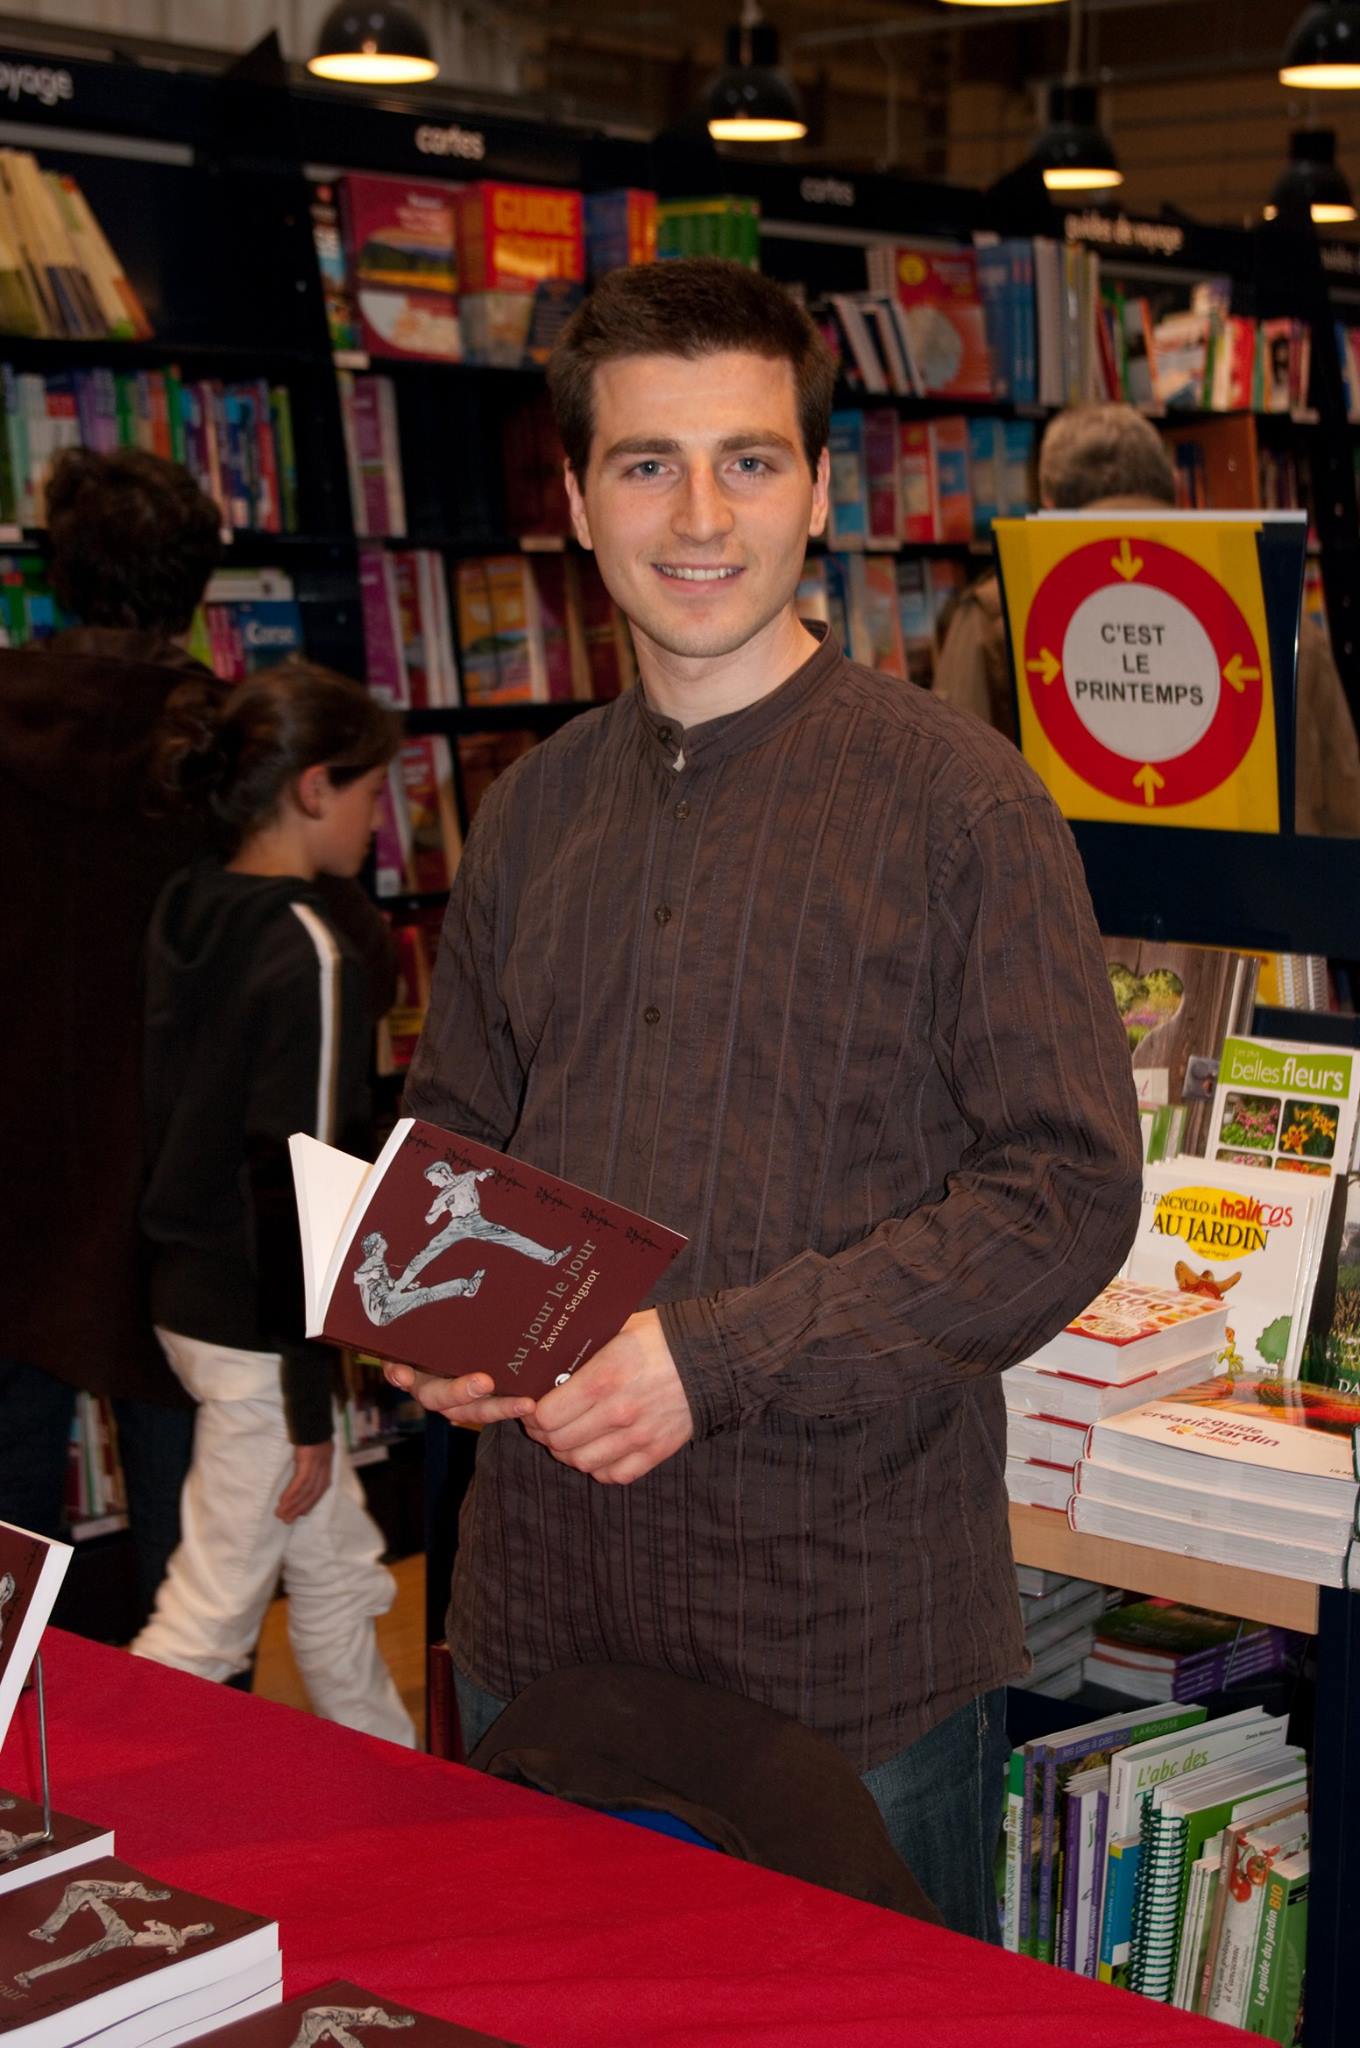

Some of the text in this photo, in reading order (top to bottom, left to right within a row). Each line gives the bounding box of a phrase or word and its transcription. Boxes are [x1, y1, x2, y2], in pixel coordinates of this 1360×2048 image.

[1101, 624, 1164, 645] C'EST
[1122, 654, 1149, 674] LE
[1075, 680, 1203, 706] PRINTEMPS
[1231, 1057, 1344, 1092] belles fleurs
[1142, 1192, 1209, 1214] L'ENCYCLO
[1220, 1196, 1293, 1227] malices
[1150, 1213, 1270, 1251] AU JARDIN
[507, 1240, 596, 1375] Au jour le jour
[540, 1269, 600, 1351] Xavier Seignot
[1212, 1419, 1263, 1433] guide
[1133, 1719, 1178, 1738] LAROUSSE
[1137, 1760, 1177, 1788] L'abc
[1182, 1748, 1209, 1772] des
[1006, 1862, 1016, 1933] DICTIONNAIRE
[1269, 1884, 1284, 1910] BIO
[1268, 1909, 1279, 1942] jardin
[1265, 1940, 1274, 1960] du
[1258, 1961, 1271, 1993] guide
[1254, 1992, 1265, 2007] Le
